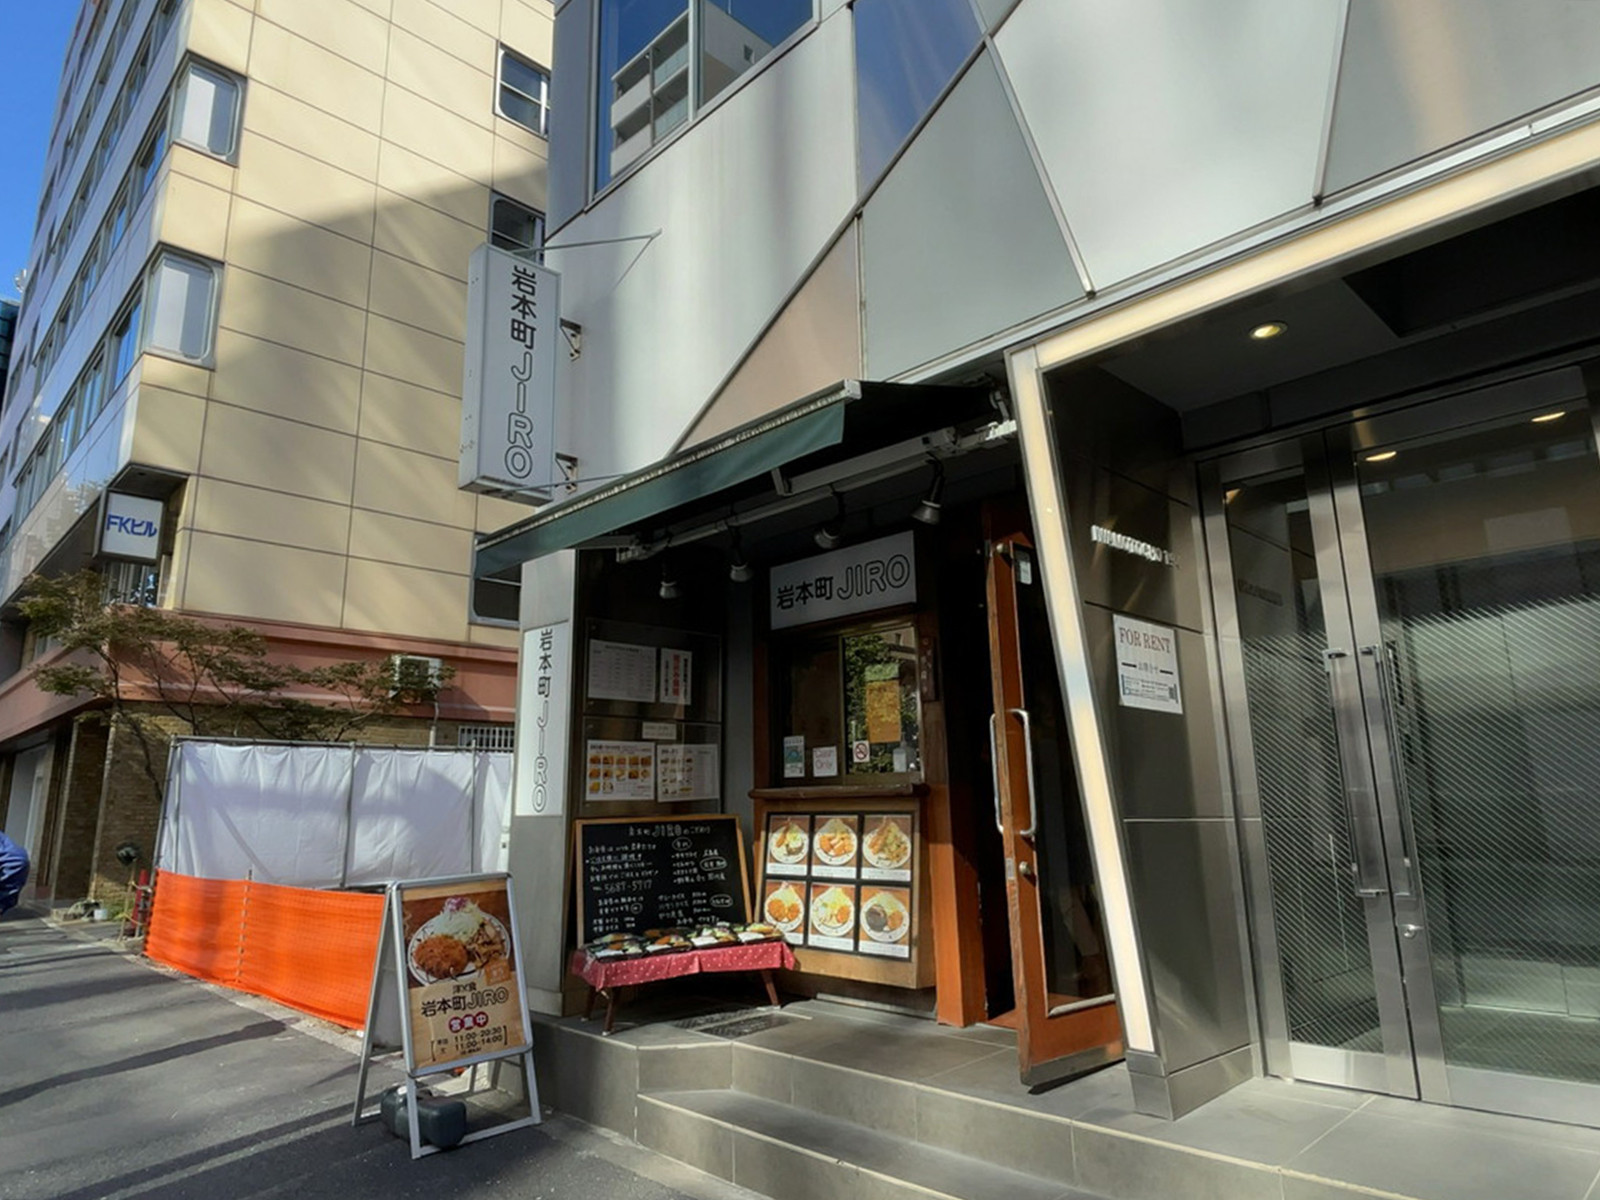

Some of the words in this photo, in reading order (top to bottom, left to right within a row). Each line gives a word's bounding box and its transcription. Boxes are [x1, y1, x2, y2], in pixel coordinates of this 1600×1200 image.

[504, 264, 537, 479] 岩本町JIRO
[106, 513, 158, 538] FKビル
[776, 553, 910, 610] 岩本町JIRO
[1118, 626, 1142, 647] FOR
[1142, 632, 1171, 653] RENT
[531, 628, 554, 813] 岩本町JIRO
[421, 986, 510, 1017] 岩本町JIRO
[450, 1013, 487, 1032] 営業中
